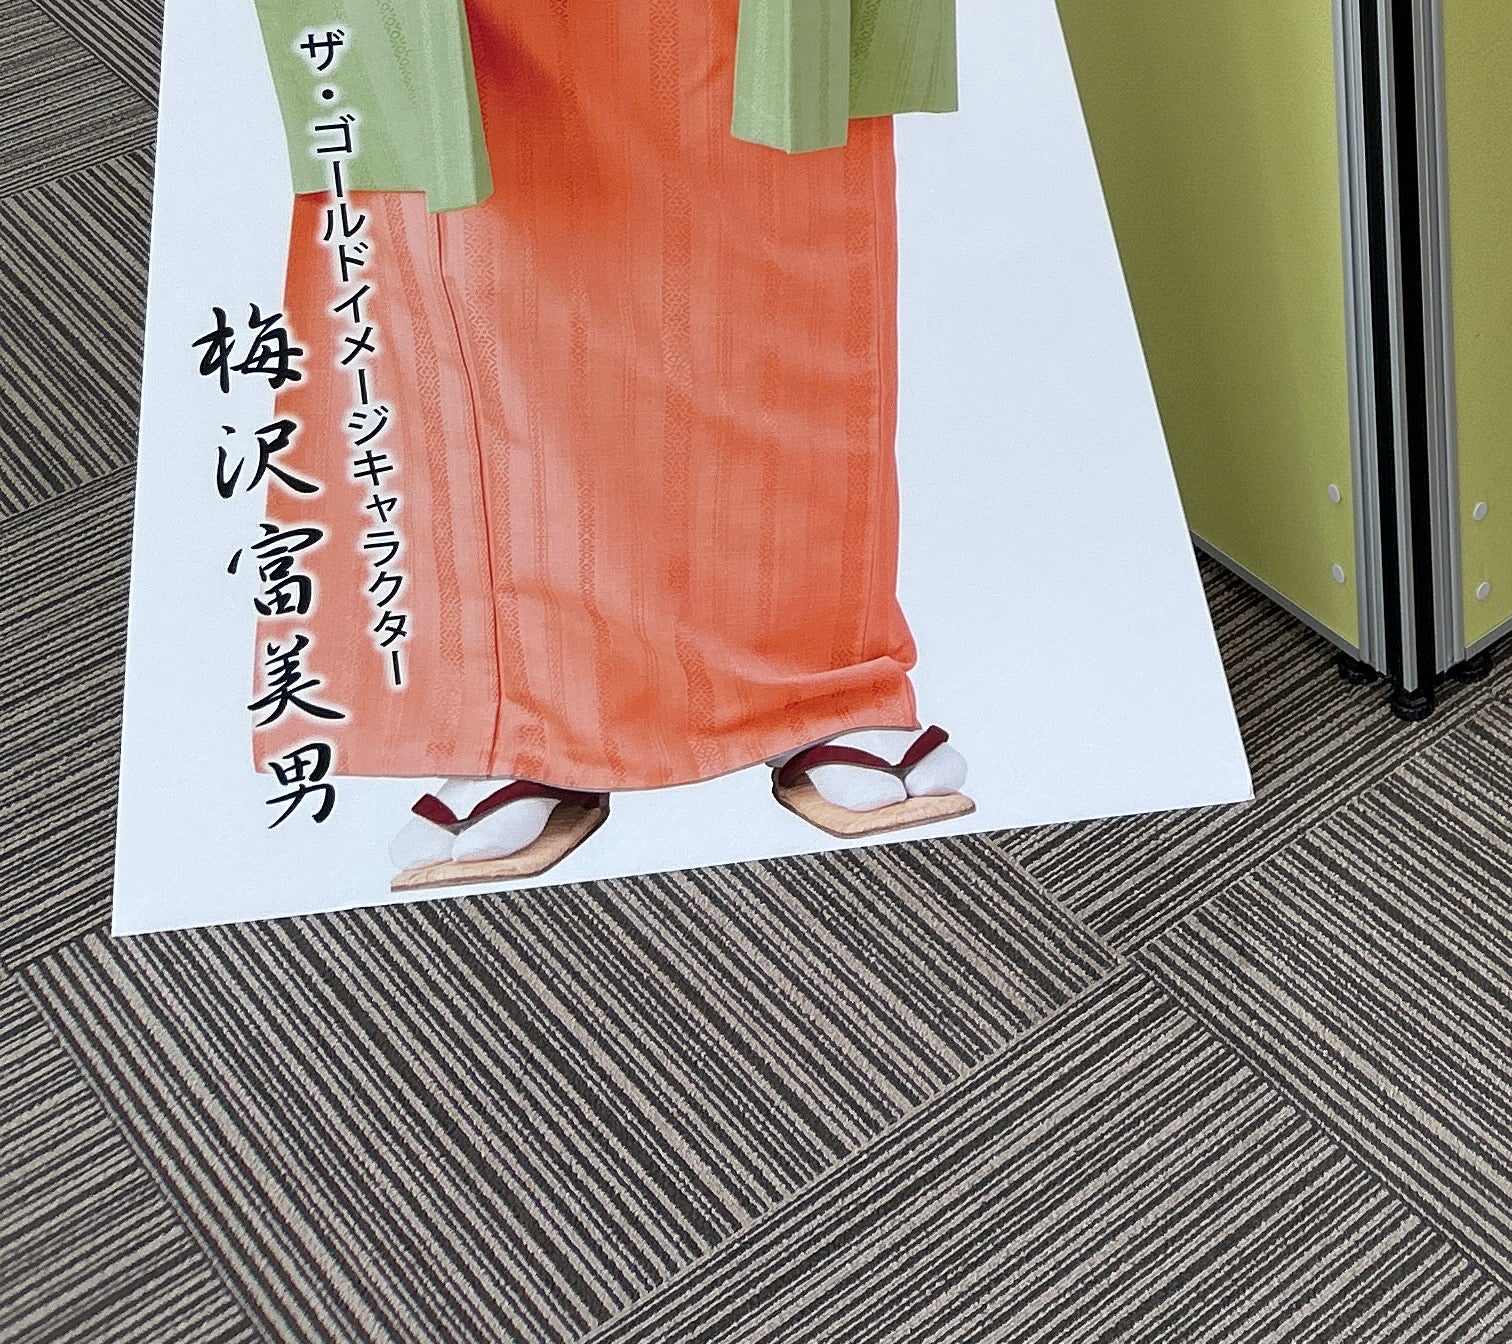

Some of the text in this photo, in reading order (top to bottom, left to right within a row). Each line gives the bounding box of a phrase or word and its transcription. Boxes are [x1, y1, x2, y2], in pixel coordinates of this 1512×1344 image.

[191, 302, 346, 830] 梅沢富美男
[299, 28, 408, 686] ザ・ゴールドイメージキャラクター
